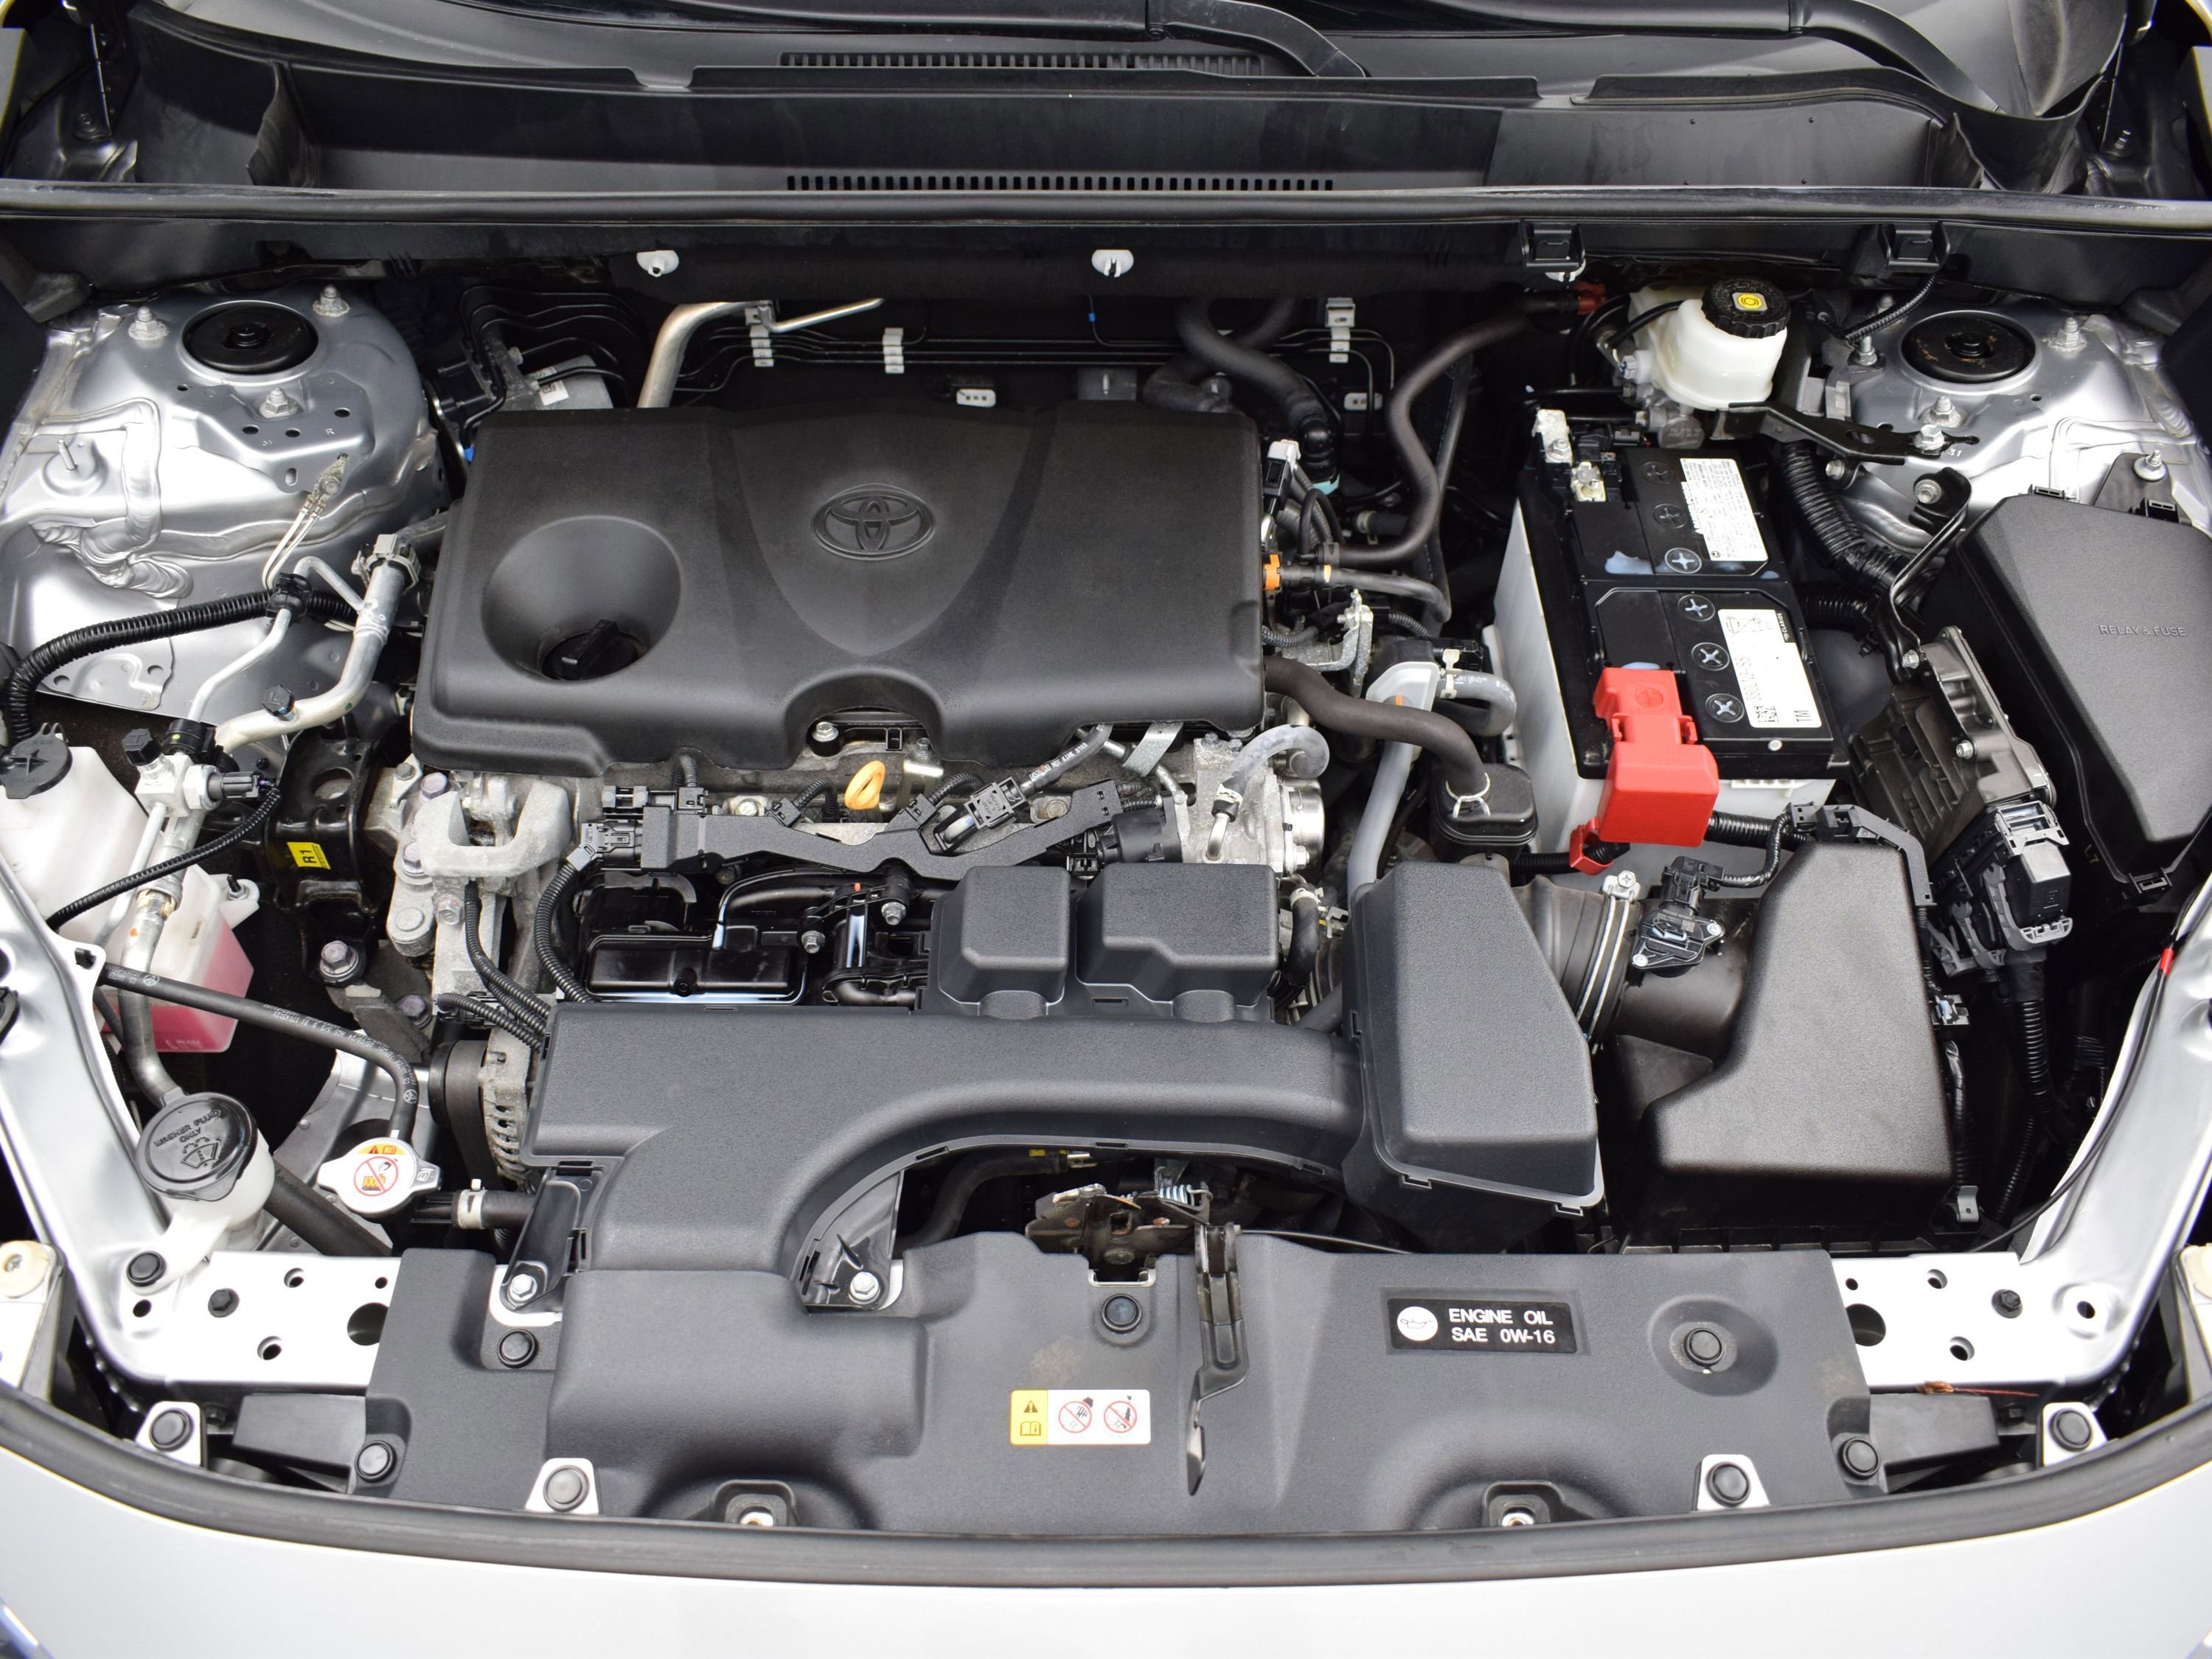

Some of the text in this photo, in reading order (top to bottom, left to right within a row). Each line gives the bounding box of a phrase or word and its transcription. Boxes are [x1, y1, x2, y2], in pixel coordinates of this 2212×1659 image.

[2098, 625, 2188, 637] RELAY & FUSE
[1794, 710, 1812, 723] TM
[299, 850, 317, 863] R1
[153, 1124, 192, 1147] WASHER
[179, 1127, 201, 1142] ONLY
[1448, 1308, 1554, 1325] ENGINE OIL
[1451, 1327, 1556, 1344] SAE 0W-16
